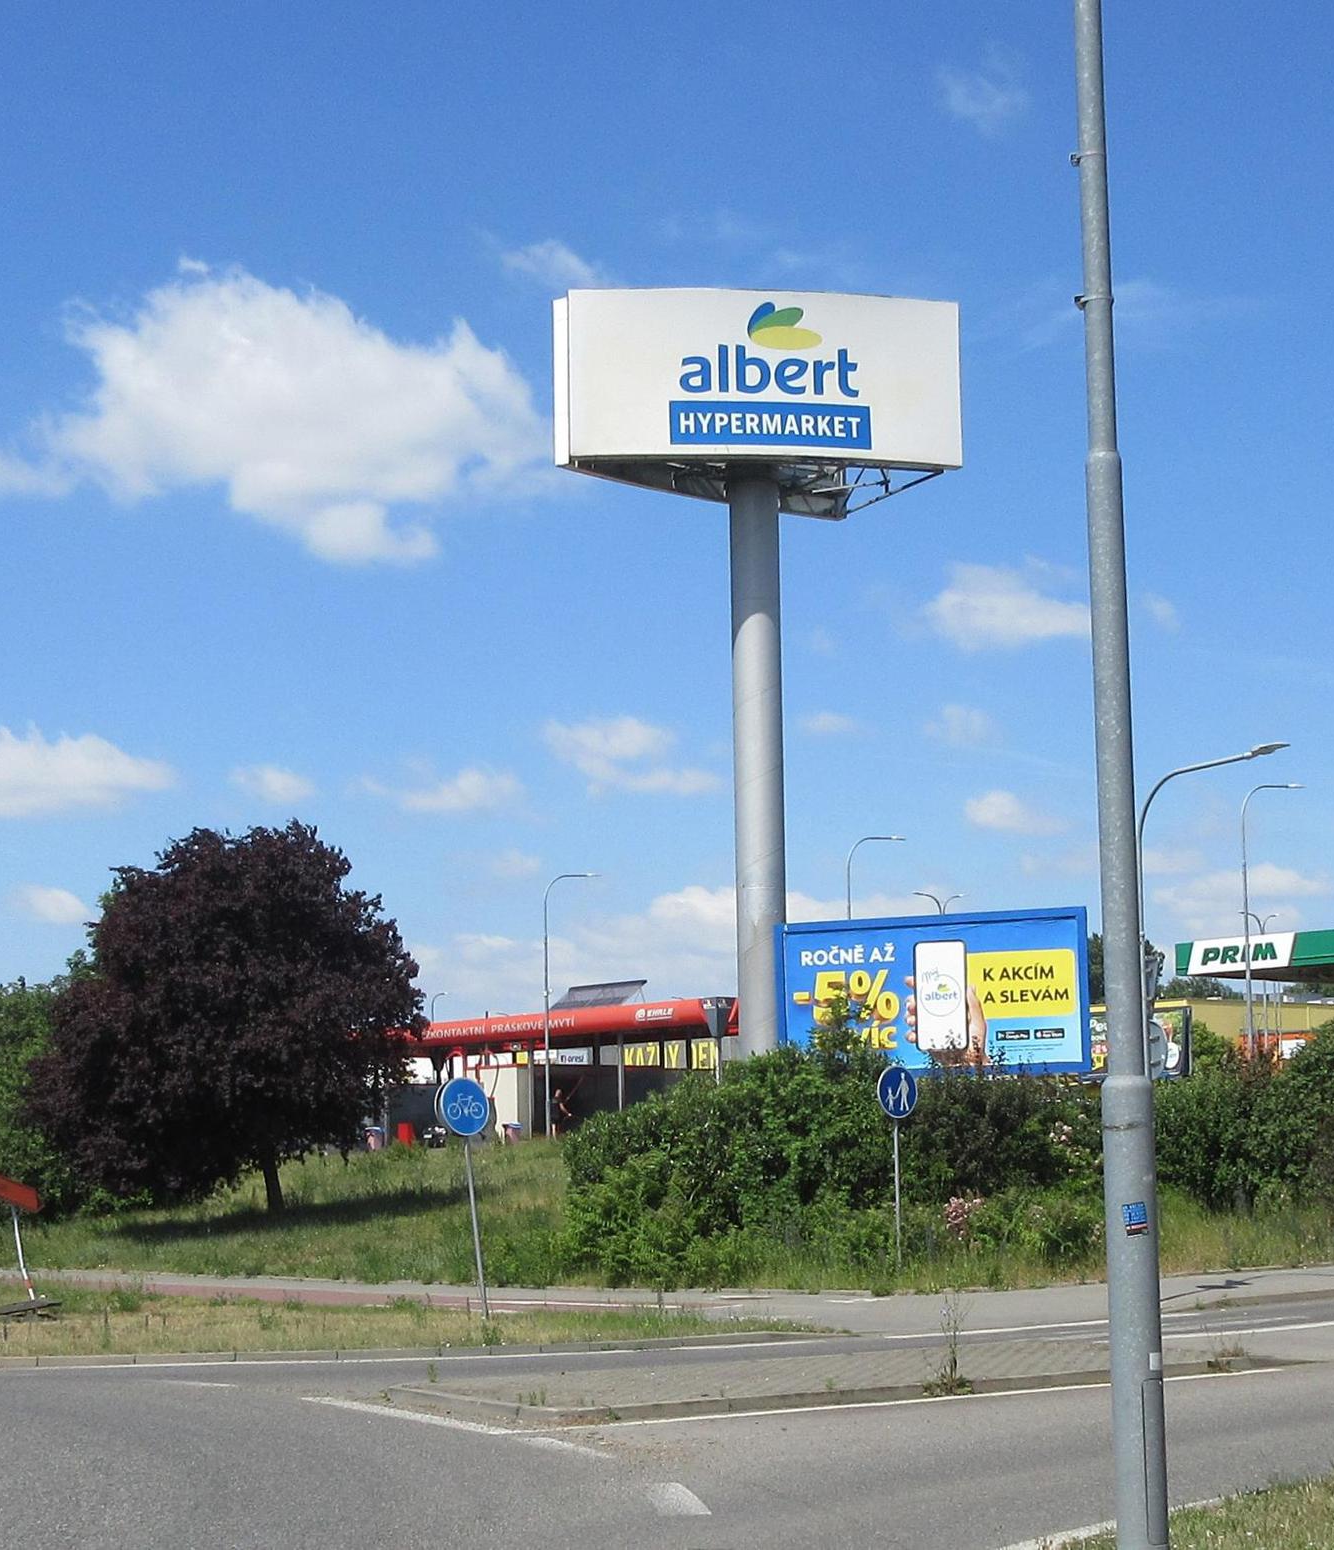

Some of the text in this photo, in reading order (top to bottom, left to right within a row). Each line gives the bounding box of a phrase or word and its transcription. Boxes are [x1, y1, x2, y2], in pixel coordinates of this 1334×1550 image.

[679, 344, 860, 398] albert
[679, 412, 861, 439] HYPERMARKET
[800, 942, 896, 966] ROČNĚ AŽ
[1200, 942, 1278, 966] PRIM
[983, 962, 1055, 982] K AKCÍM
[793, 969, 900, 1024] -5%
[924, 991, 958, 1001] albert
[983, 985, 1070, 1004] A SLEVÁM
[422, 1021, 486, 1040] ZKONTAKTNÍ
